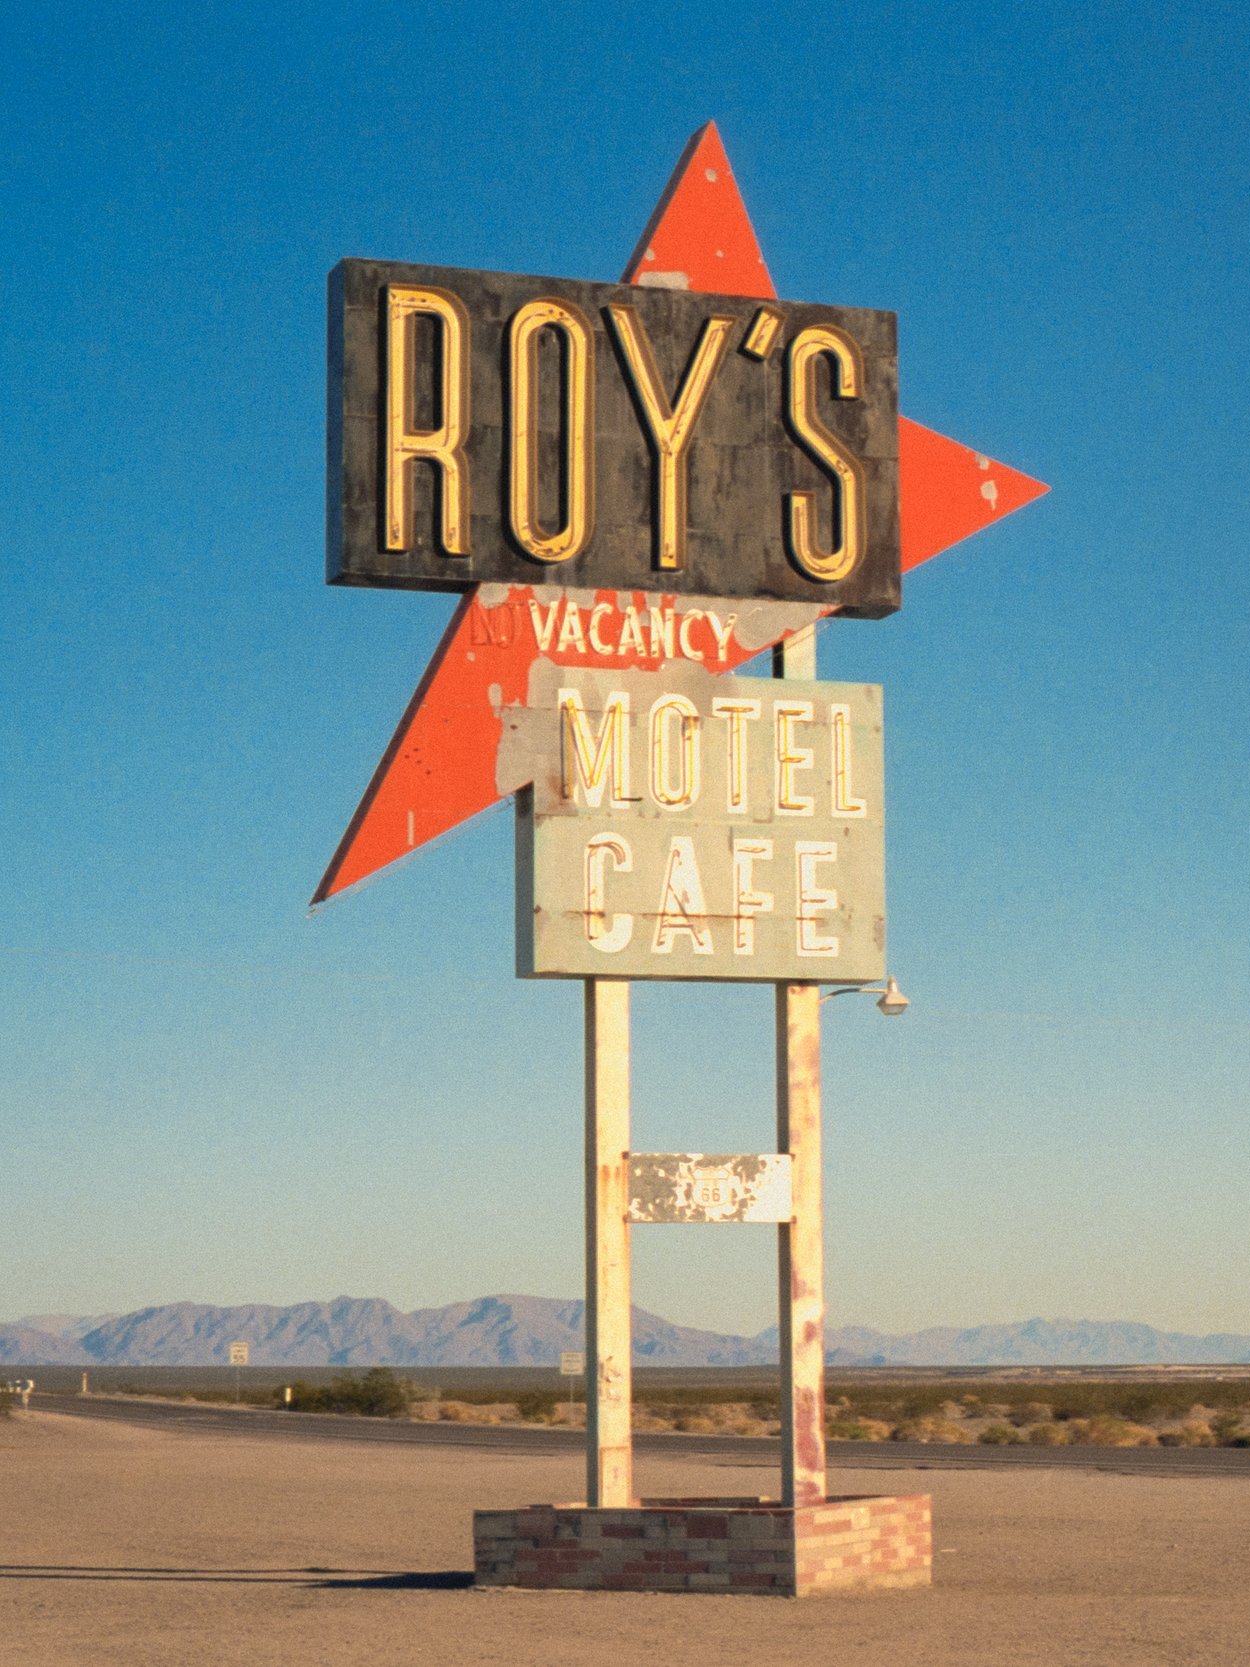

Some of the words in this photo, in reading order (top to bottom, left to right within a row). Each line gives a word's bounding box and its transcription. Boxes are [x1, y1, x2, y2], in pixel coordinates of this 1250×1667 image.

[382, 282, 868, 584] ROY'S
[529, 599, 737, 661] VACANCY
[557, 688, 867, 818] MOTEL
[584, 831, 840, 957] CAFE
[702, 1187, 720, 1202] 66
